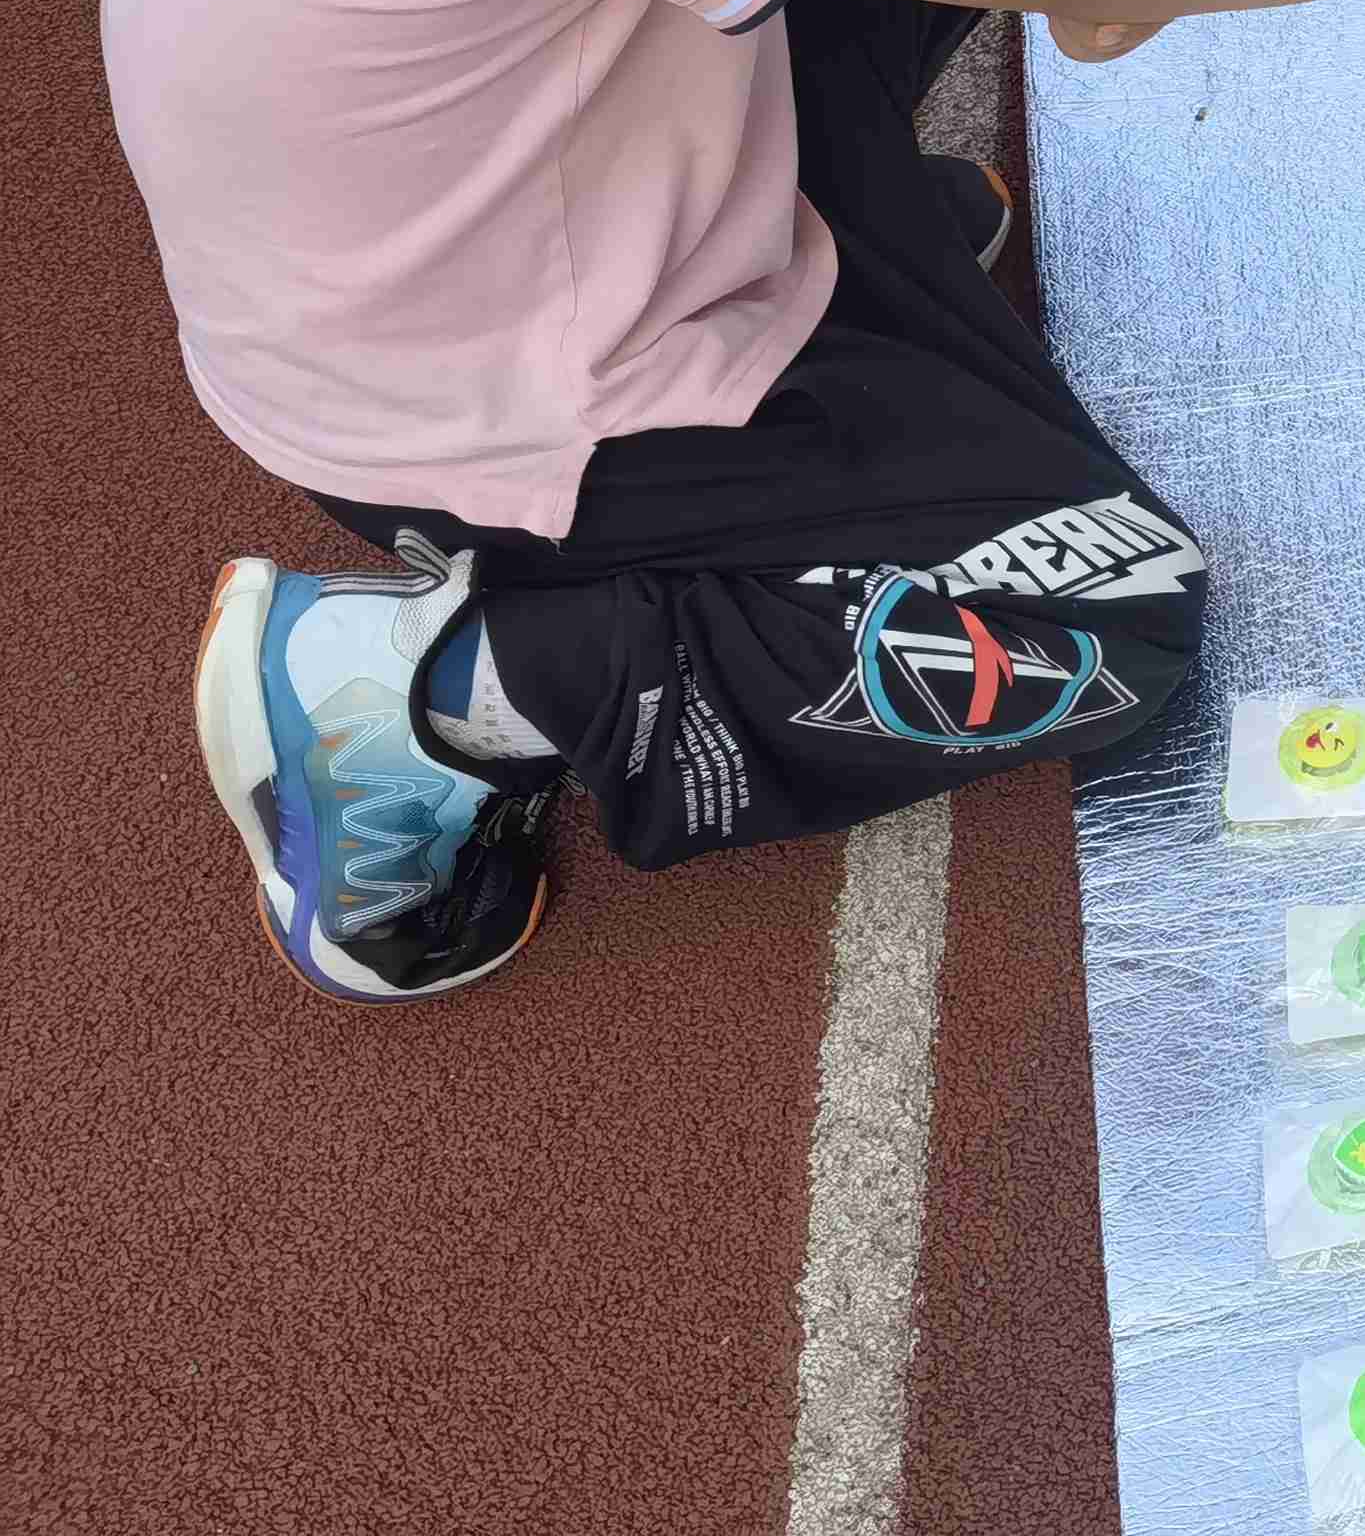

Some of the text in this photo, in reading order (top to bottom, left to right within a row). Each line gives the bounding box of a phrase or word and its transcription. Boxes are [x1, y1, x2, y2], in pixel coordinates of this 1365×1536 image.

[714, 722, 738, 753] THINK
[682, 768, 694, 788] THE
[695, 754, 713, 783] WHAT
